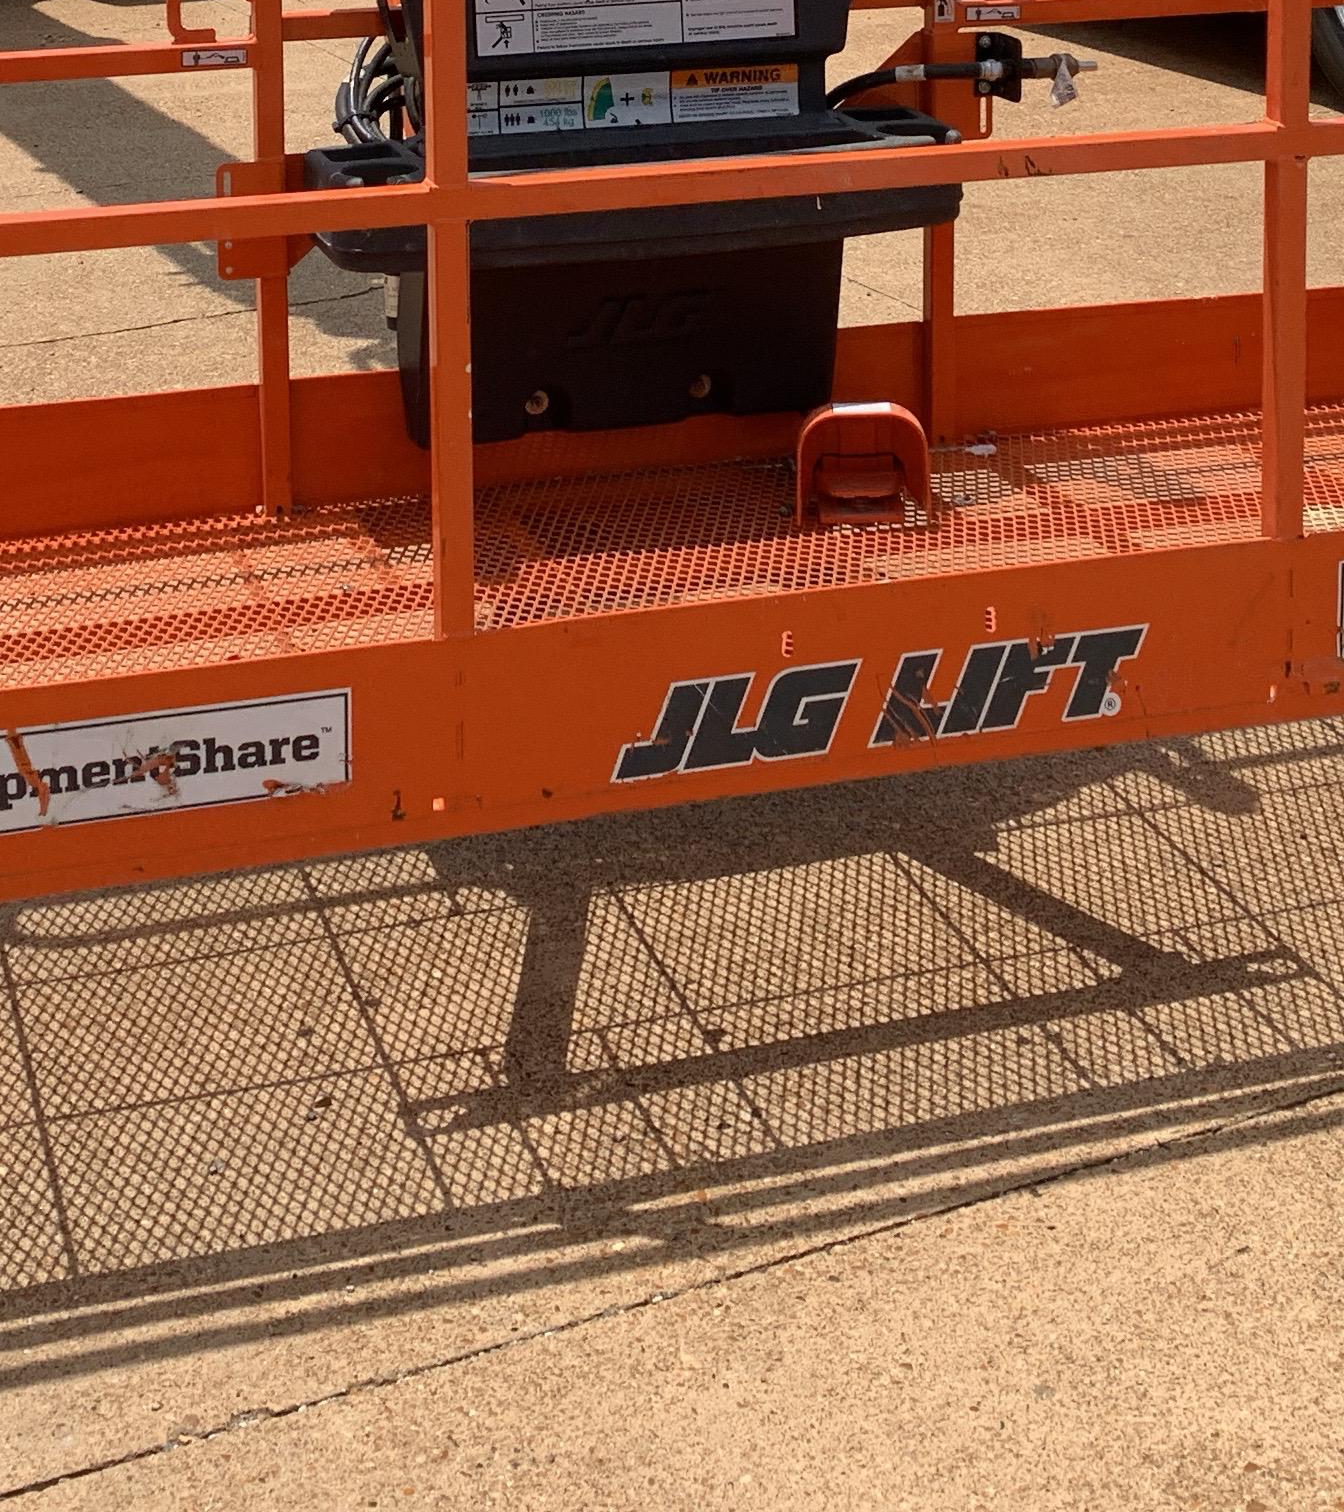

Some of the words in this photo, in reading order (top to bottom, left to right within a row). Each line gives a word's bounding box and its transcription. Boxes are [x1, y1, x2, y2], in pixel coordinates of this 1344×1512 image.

[703, 68, 782, 85] WARNING
[609, 658, 863, 784] JLG
[866, 622, 1150, 749] LIFT
